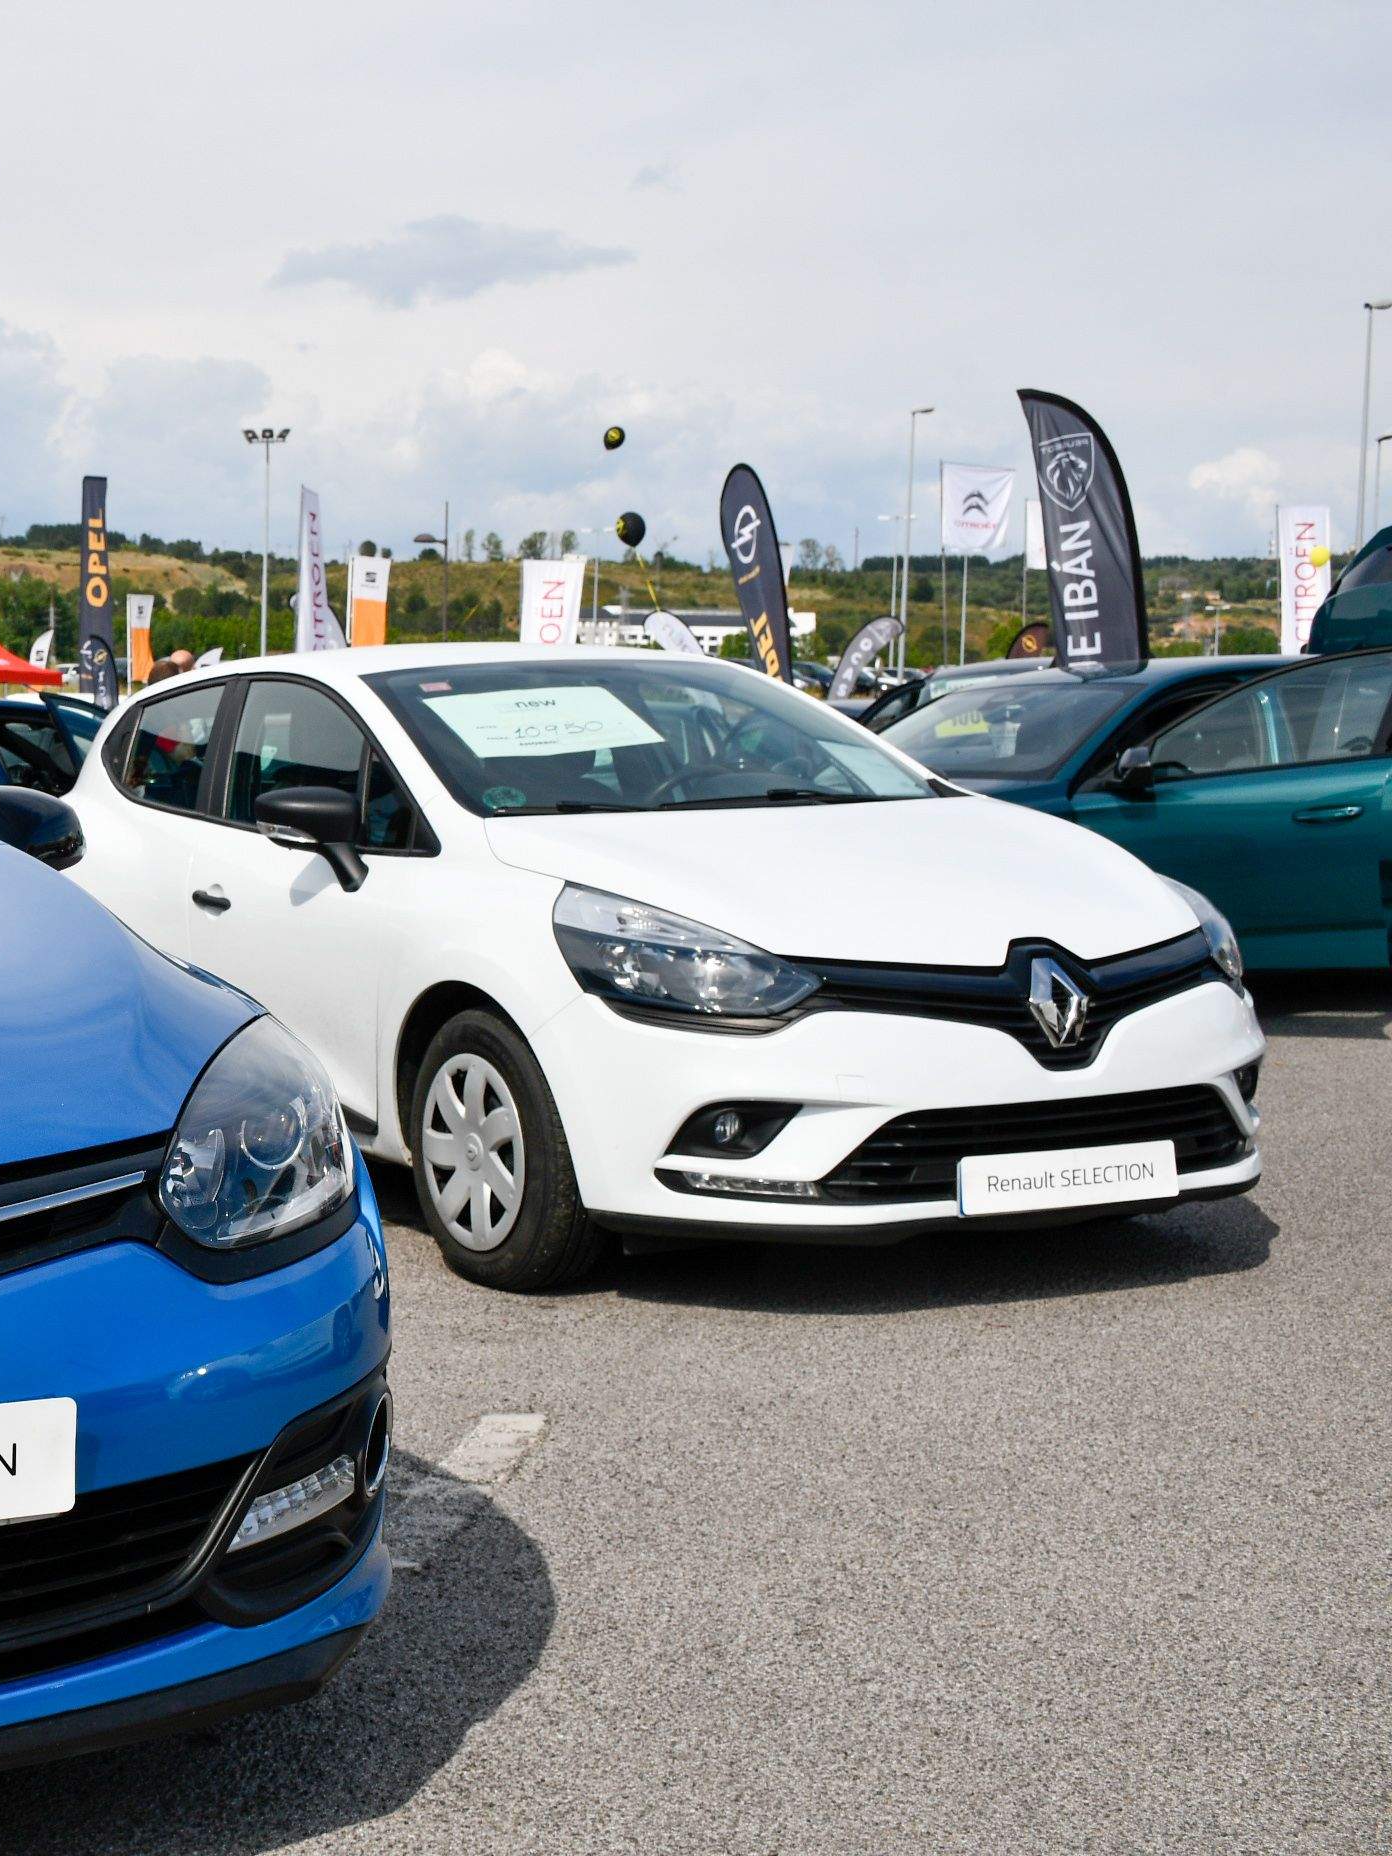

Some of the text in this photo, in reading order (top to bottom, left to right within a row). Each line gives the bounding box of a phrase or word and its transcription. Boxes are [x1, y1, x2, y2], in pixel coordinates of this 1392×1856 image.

[86, 508, 108, 607] OPEL
[1051, 521, 1099, 621] IBÁN
[988, 1162, 1154, 1193] Renault SELECTION
